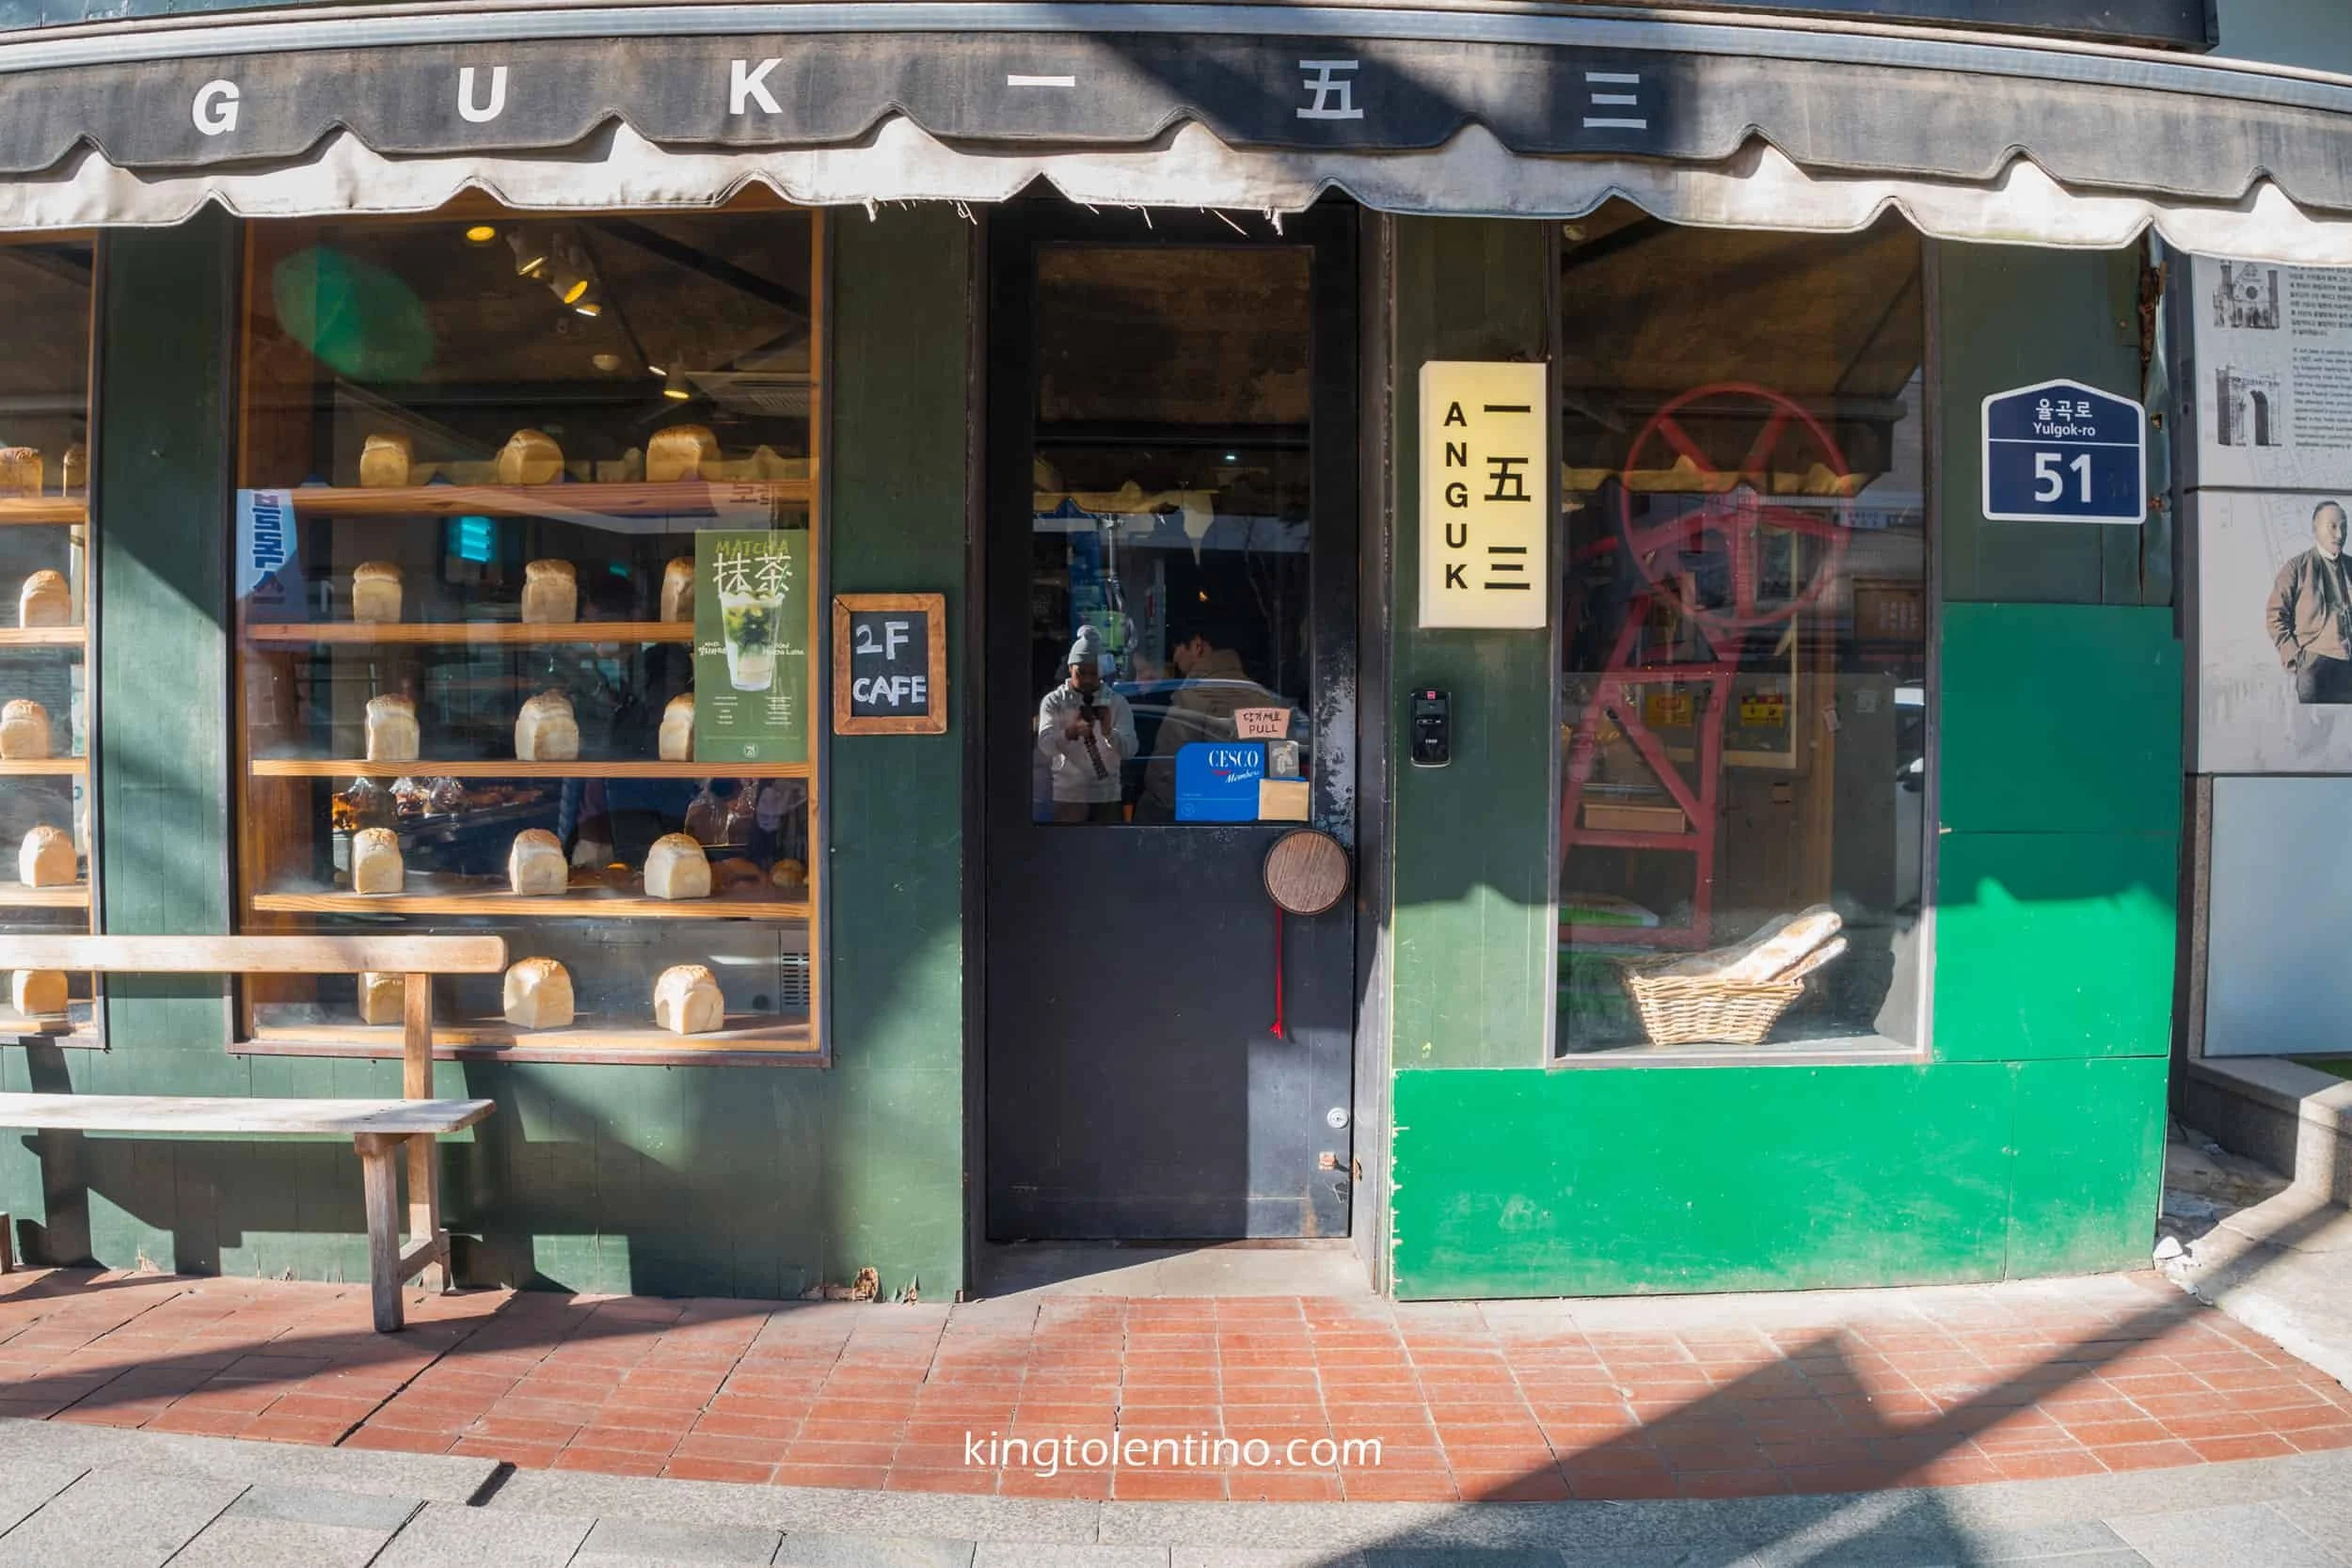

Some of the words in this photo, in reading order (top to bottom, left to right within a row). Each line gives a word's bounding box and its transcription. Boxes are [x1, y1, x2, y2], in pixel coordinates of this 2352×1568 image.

[2035, 398, 2093, 422] 율곡로
[2033, 422, 2096, 438] Yulgok-ro
[2034, 451, 2091, 503] 51
[1443, 401, 1469, 590] ANGUK
[1484, 404, 1532, 591] 一五三
[715, 537, 788, 559] MATCHA
[712, 551, 793, 594] 抹茶
[855, 621, 910, 660] 2F
[852, 674, 927, 706] CAFE
[1248, 723, 1279, 735] PULL
[1208, 749, 1260, 768] CESCO
